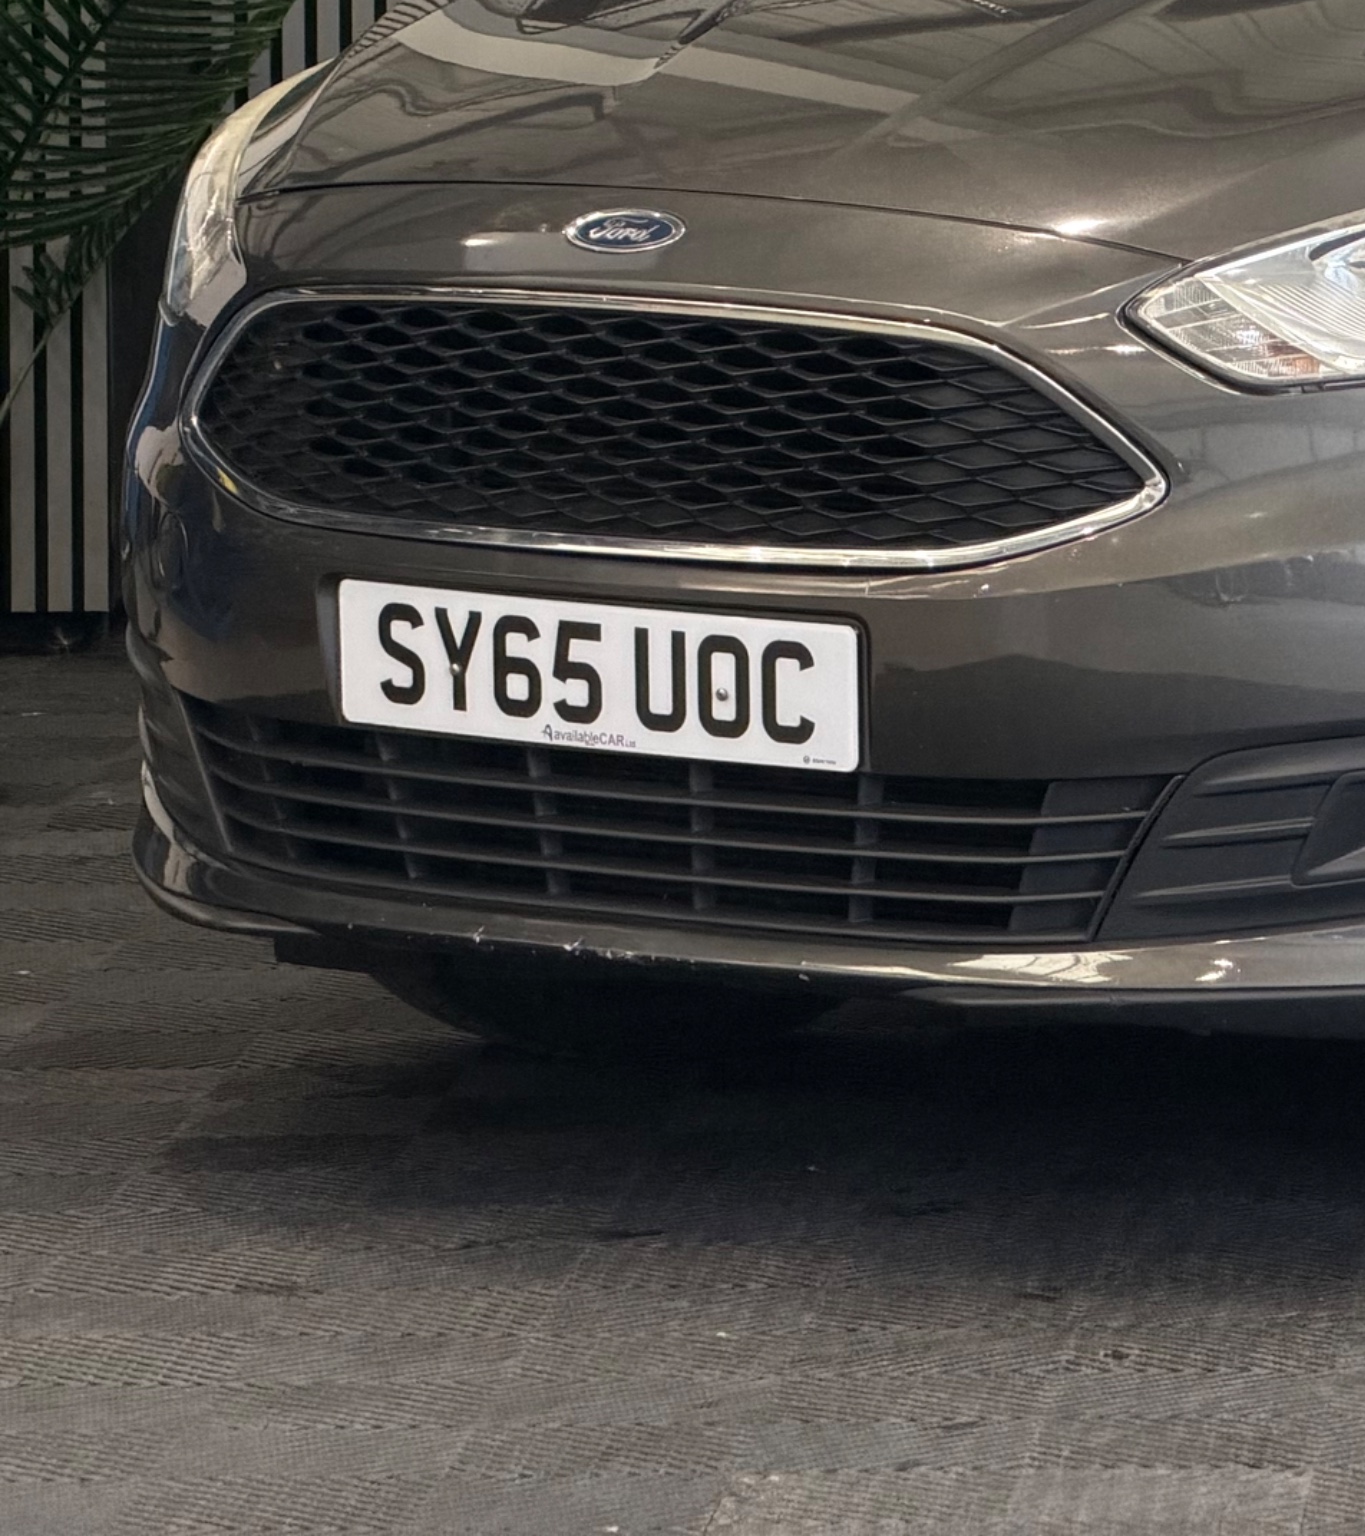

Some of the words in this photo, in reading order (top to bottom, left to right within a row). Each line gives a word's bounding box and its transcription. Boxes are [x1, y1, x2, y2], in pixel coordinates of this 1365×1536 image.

[589, 217, 660, 241] Ford
[377, 602, 603, 724] SY65
[634, 626, 815, 745] UOC
